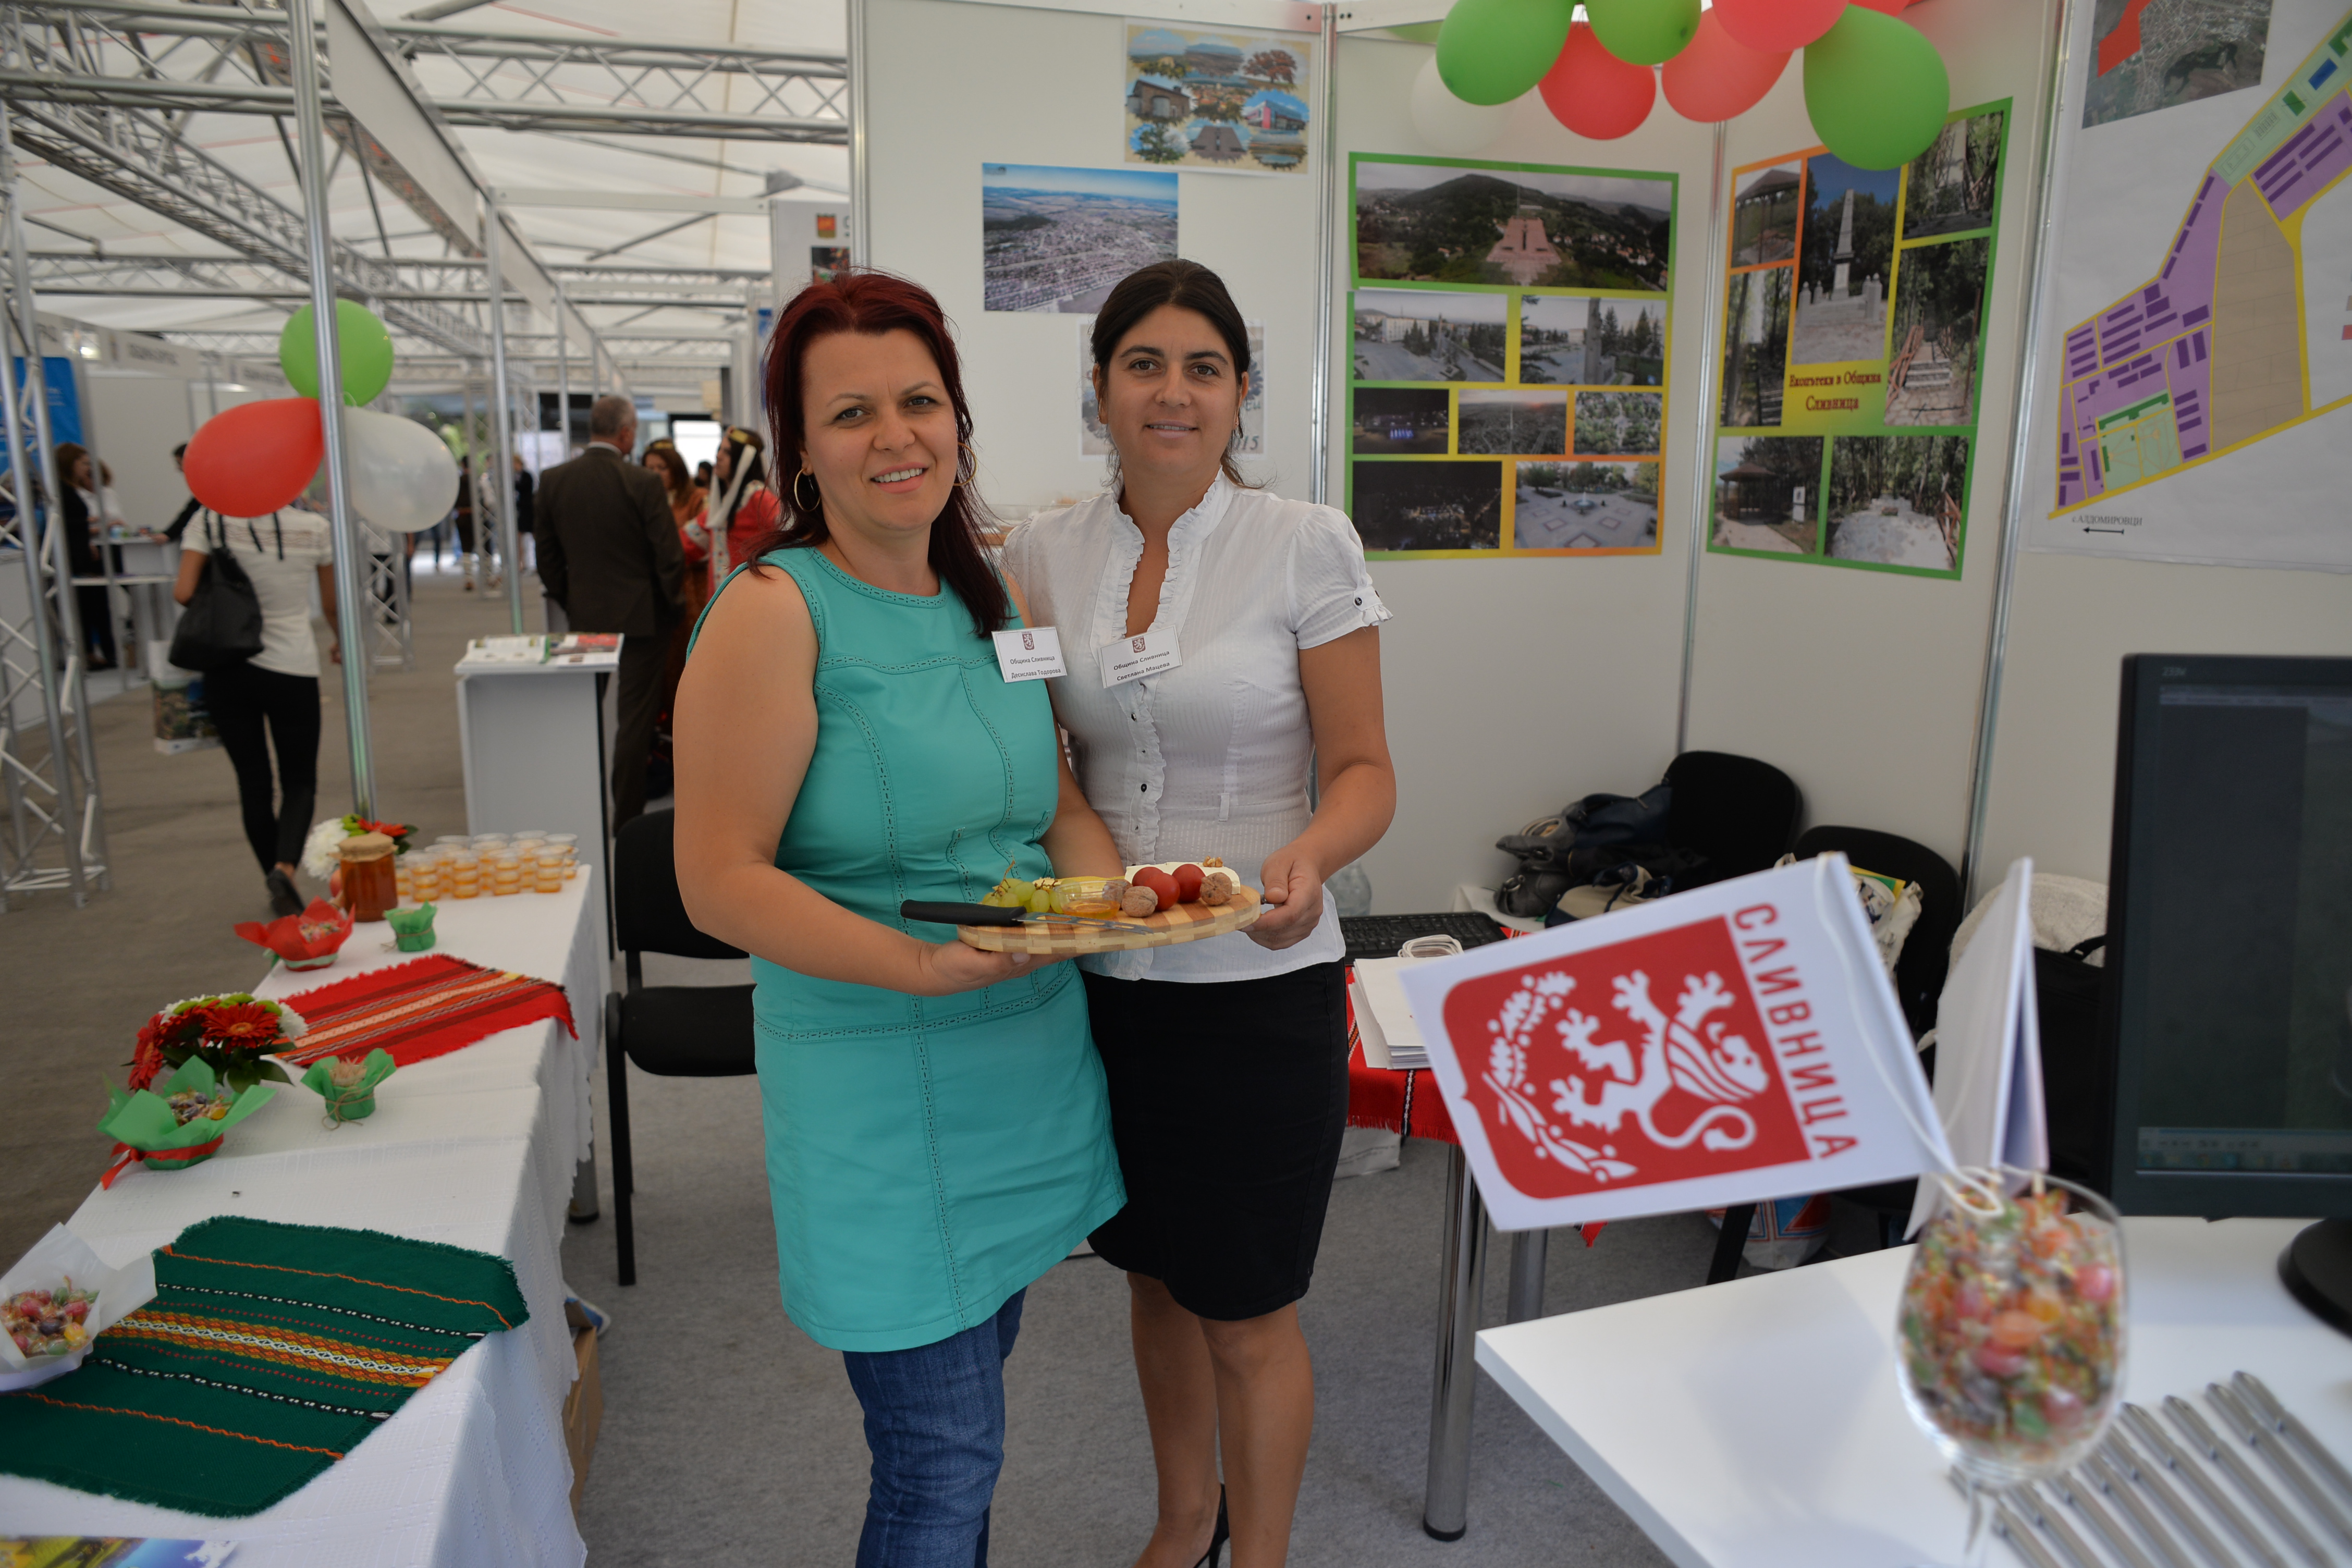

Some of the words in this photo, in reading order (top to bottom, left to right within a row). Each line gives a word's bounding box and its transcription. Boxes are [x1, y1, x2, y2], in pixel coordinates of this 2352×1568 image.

[1836, 375, 1842, 385] в
[1844, 370, 1881, 386] Община
[1806, 395, 1859, 412] Сливница
[1113, 659, 1138, 670] Община
[1140, 651, 1170, 663] Сливница
[1117, 669, 1144, 681] Светлана
[1146, 662, 1170, 672] Мацева
[1733, 902, 1859, 1160] СЛИВНИЦА
